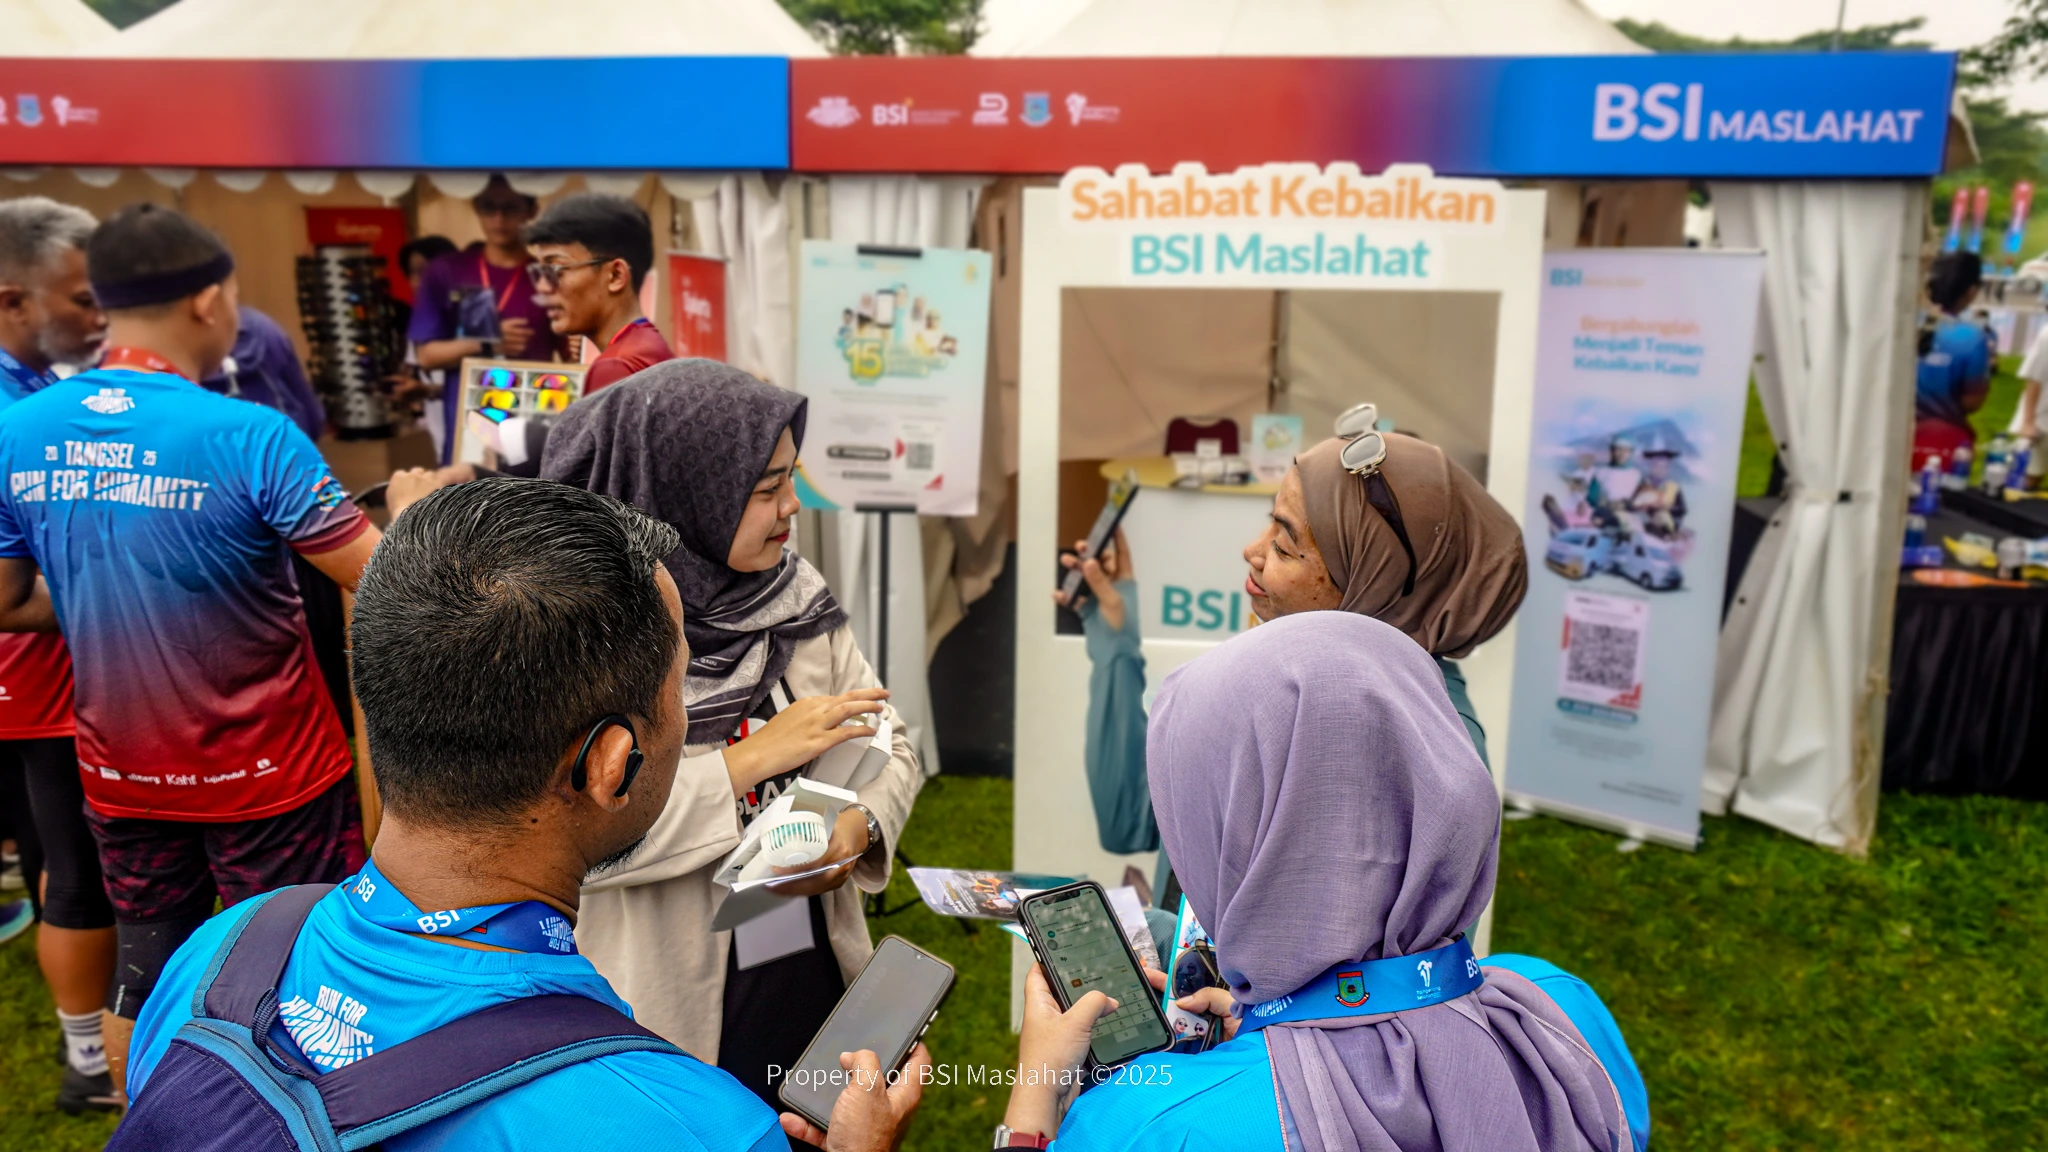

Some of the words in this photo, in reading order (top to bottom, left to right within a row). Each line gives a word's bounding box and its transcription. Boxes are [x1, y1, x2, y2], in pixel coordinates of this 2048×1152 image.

[872, 103, 908, 126] BSI
[1592, 83, 1703, 141] BSI
[1708, 110, 1923, 143] MASLAHAT
[1071, 176, 1260, 222] Sahabat
[1269, 175, 1496, 224] Kebaikan
[1131, 234, 1203, 275] BSI
[1214, 233, 1431, 277] Maslahat
[846, 341, 883, 379] 15
[64, 440, 135, 469] TANGSEL
[52, 470, 89, 501] FOR
[93, 471, 210, 511] HUMANITY
[1161, 584, 1241, 632] BSI
[357, 873, 377, 903] BSI
[417, 909, 460, 934] BSI
[316, 985, 343, 1016] RUN
[338, 996, 368, 1028] FOR
